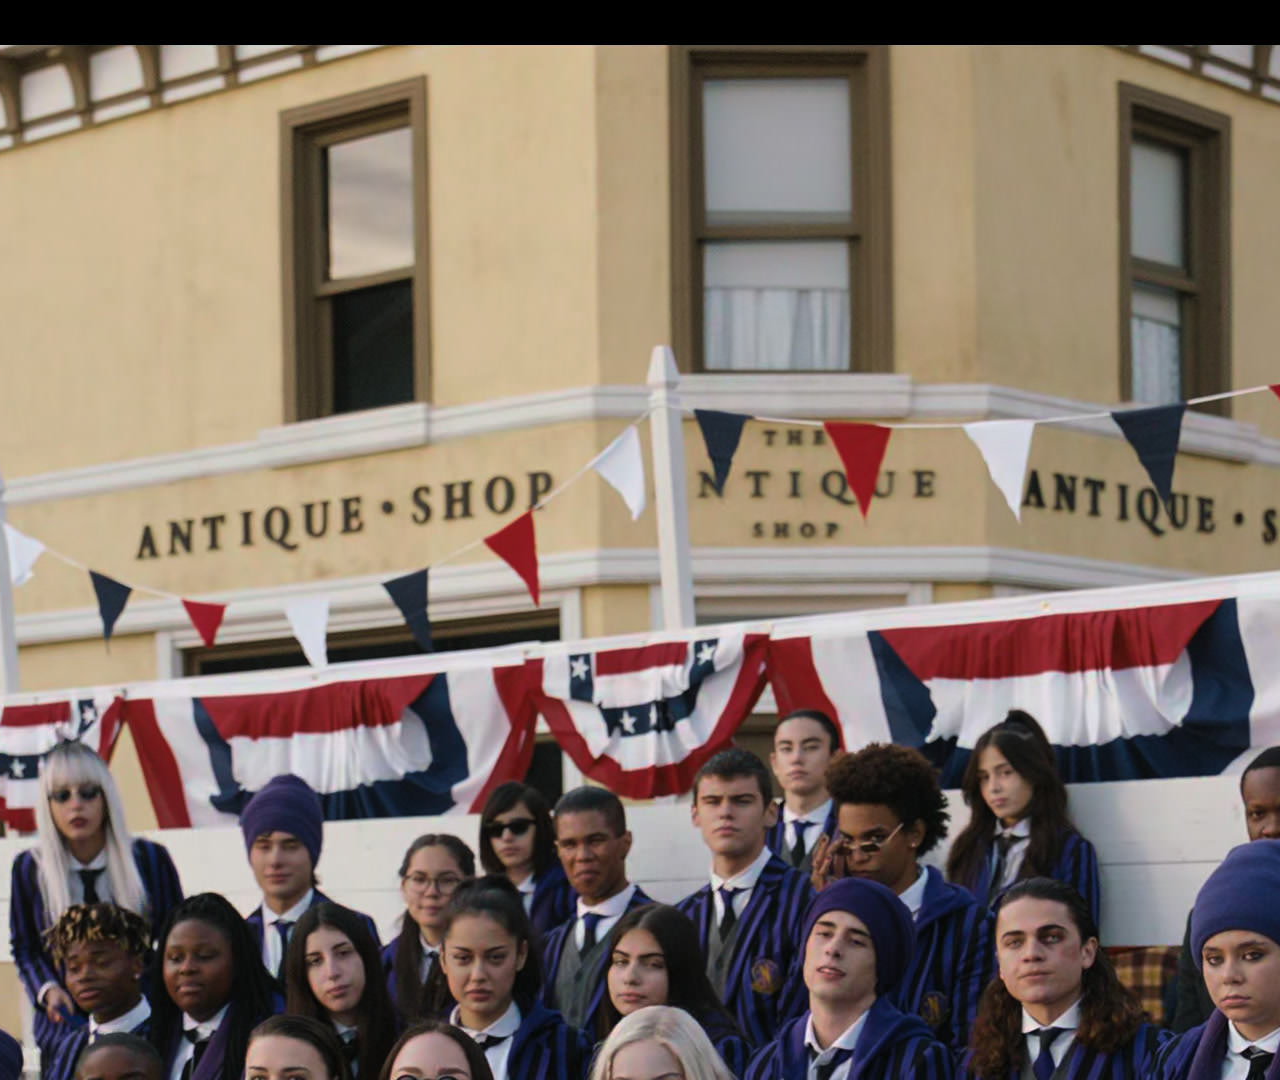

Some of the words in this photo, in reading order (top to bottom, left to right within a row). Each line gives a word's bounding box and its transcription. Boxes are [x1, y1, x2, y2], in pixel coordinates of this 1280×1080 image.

[762, 430, 826, 446] THE
[697, 470, 936, 505] NTIQUE
[1022, 469, 1217, 537] ANTIQUE
[136, 496, 365, 560] ANTIQUE
[411, 471, 553, 525] SHOP
[752, 522, 840, 539] SHOP
